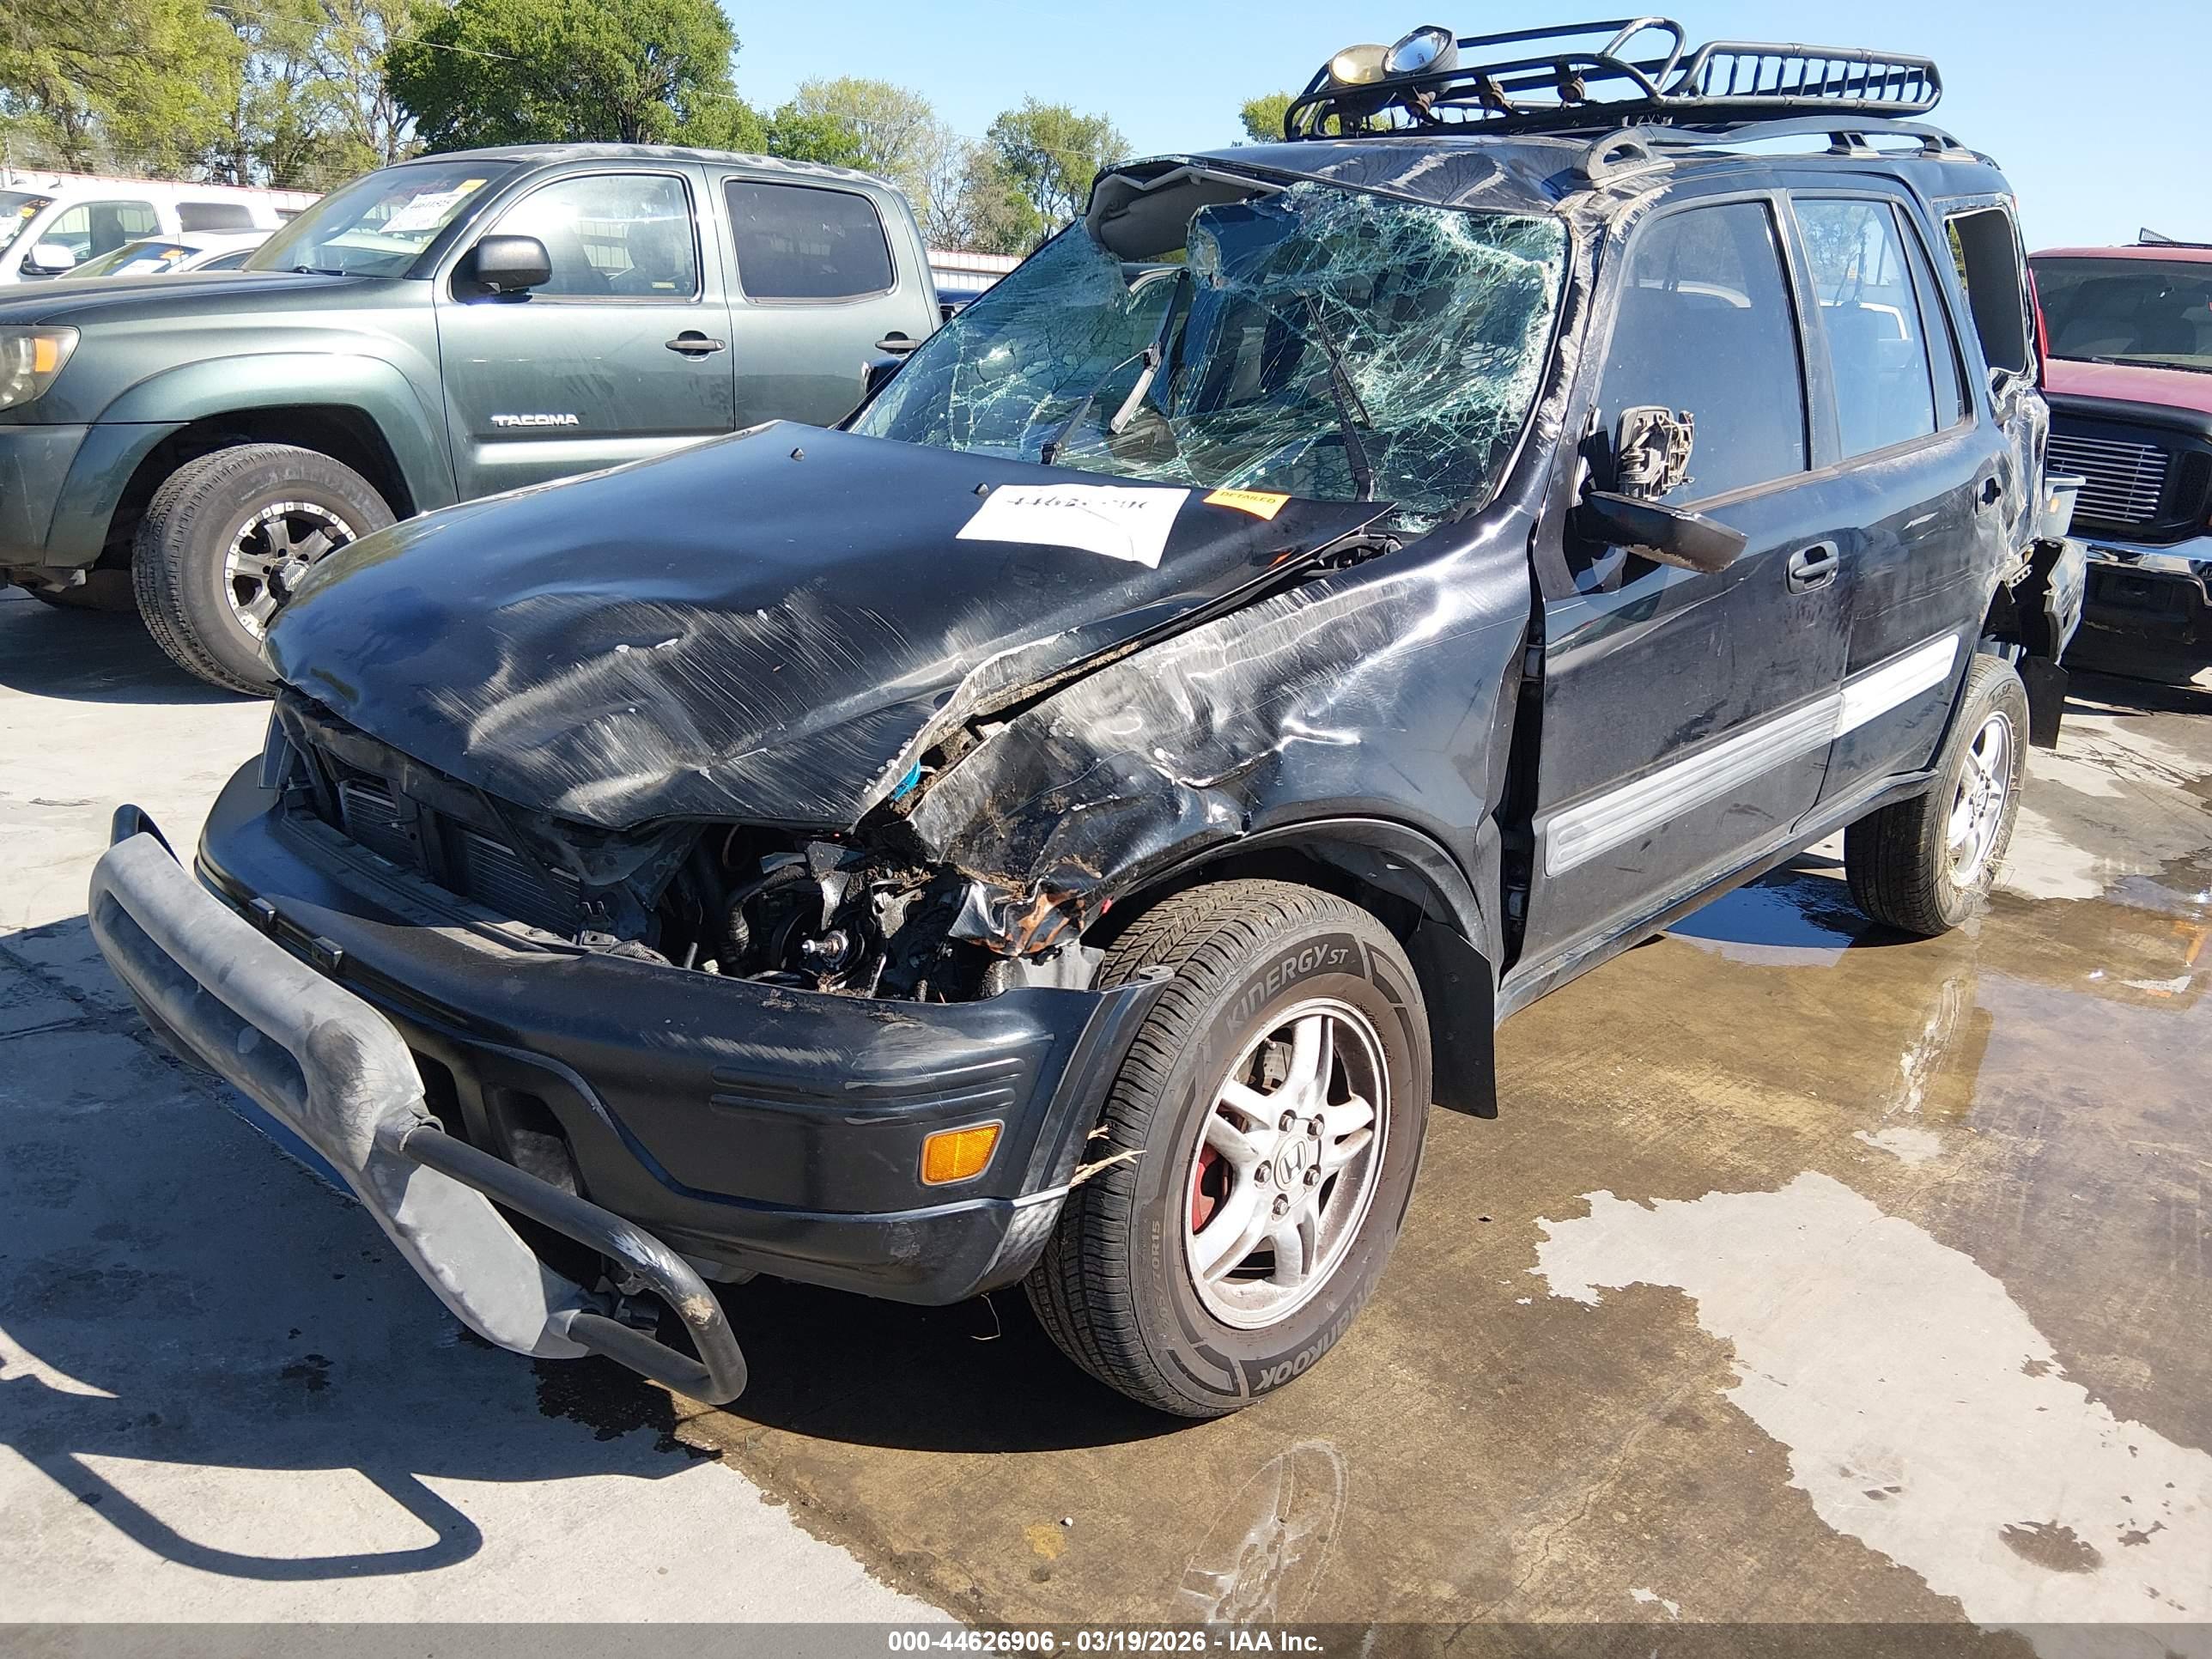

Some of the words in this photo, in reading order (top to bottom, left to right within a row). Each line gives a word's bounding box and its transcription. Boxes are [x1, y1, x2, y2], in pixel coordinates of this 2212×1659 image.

[490, 414, 580, 427] TACOMA
[1219, 491, 1276, 504] DETAILED
[1328, 949, 1349, 964] ST
